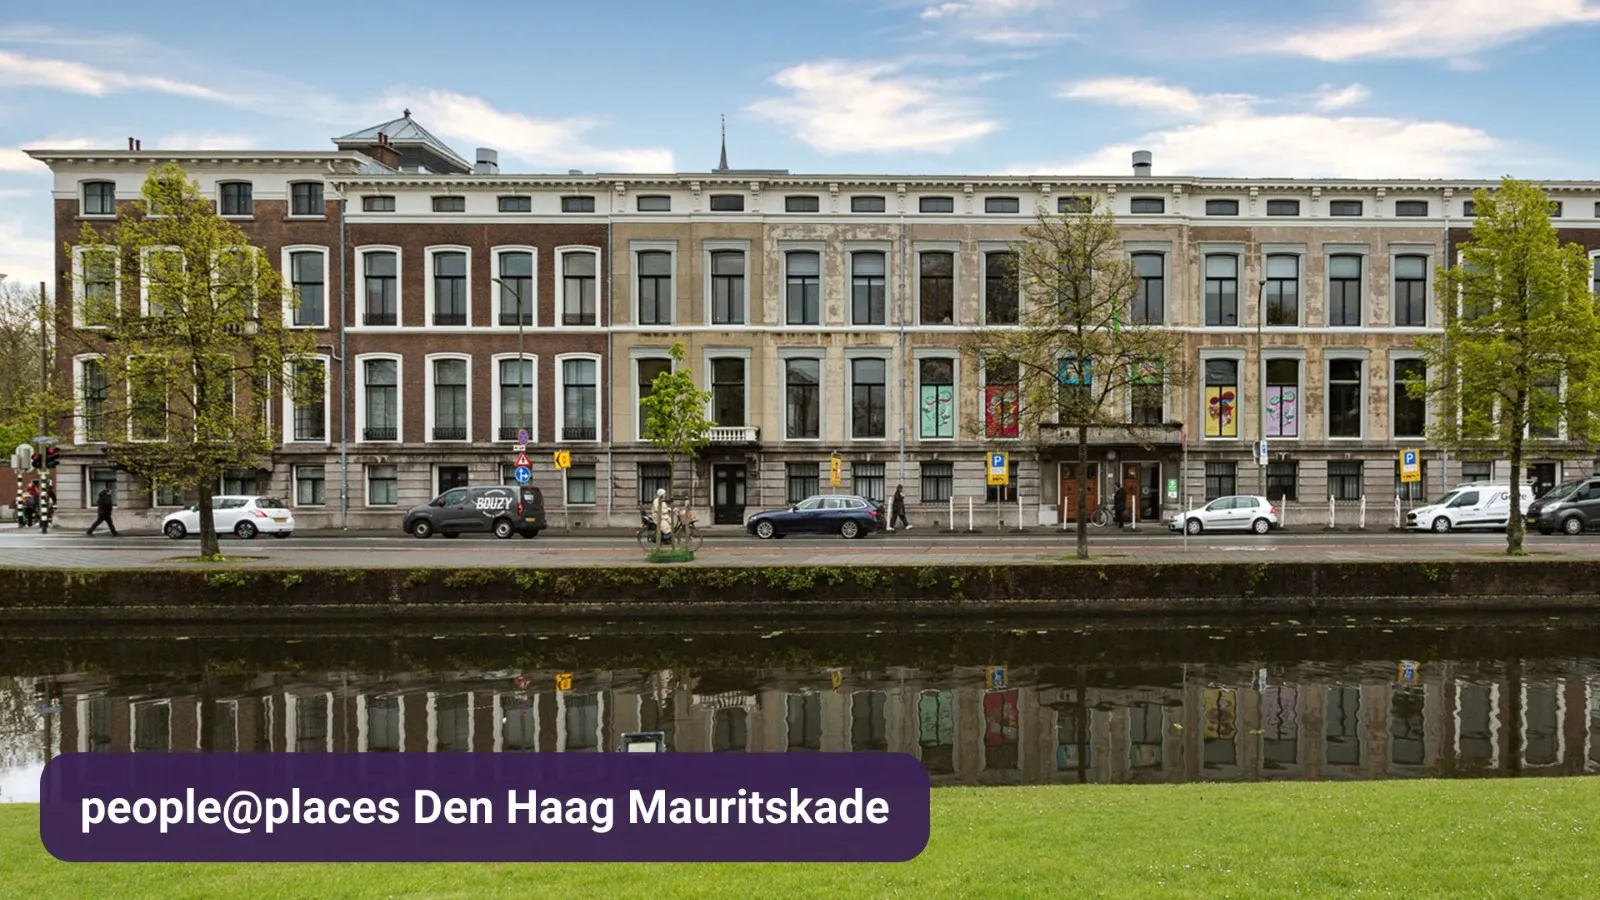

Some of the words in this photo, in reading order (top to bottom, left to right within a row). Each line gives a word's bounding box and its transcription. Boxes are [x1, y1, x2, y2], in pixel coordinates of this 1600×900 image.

[994, 455, 1002, 467] P
[1406, 453, 1414, 464] P
[476, 497, 513, 510] BOUZY
